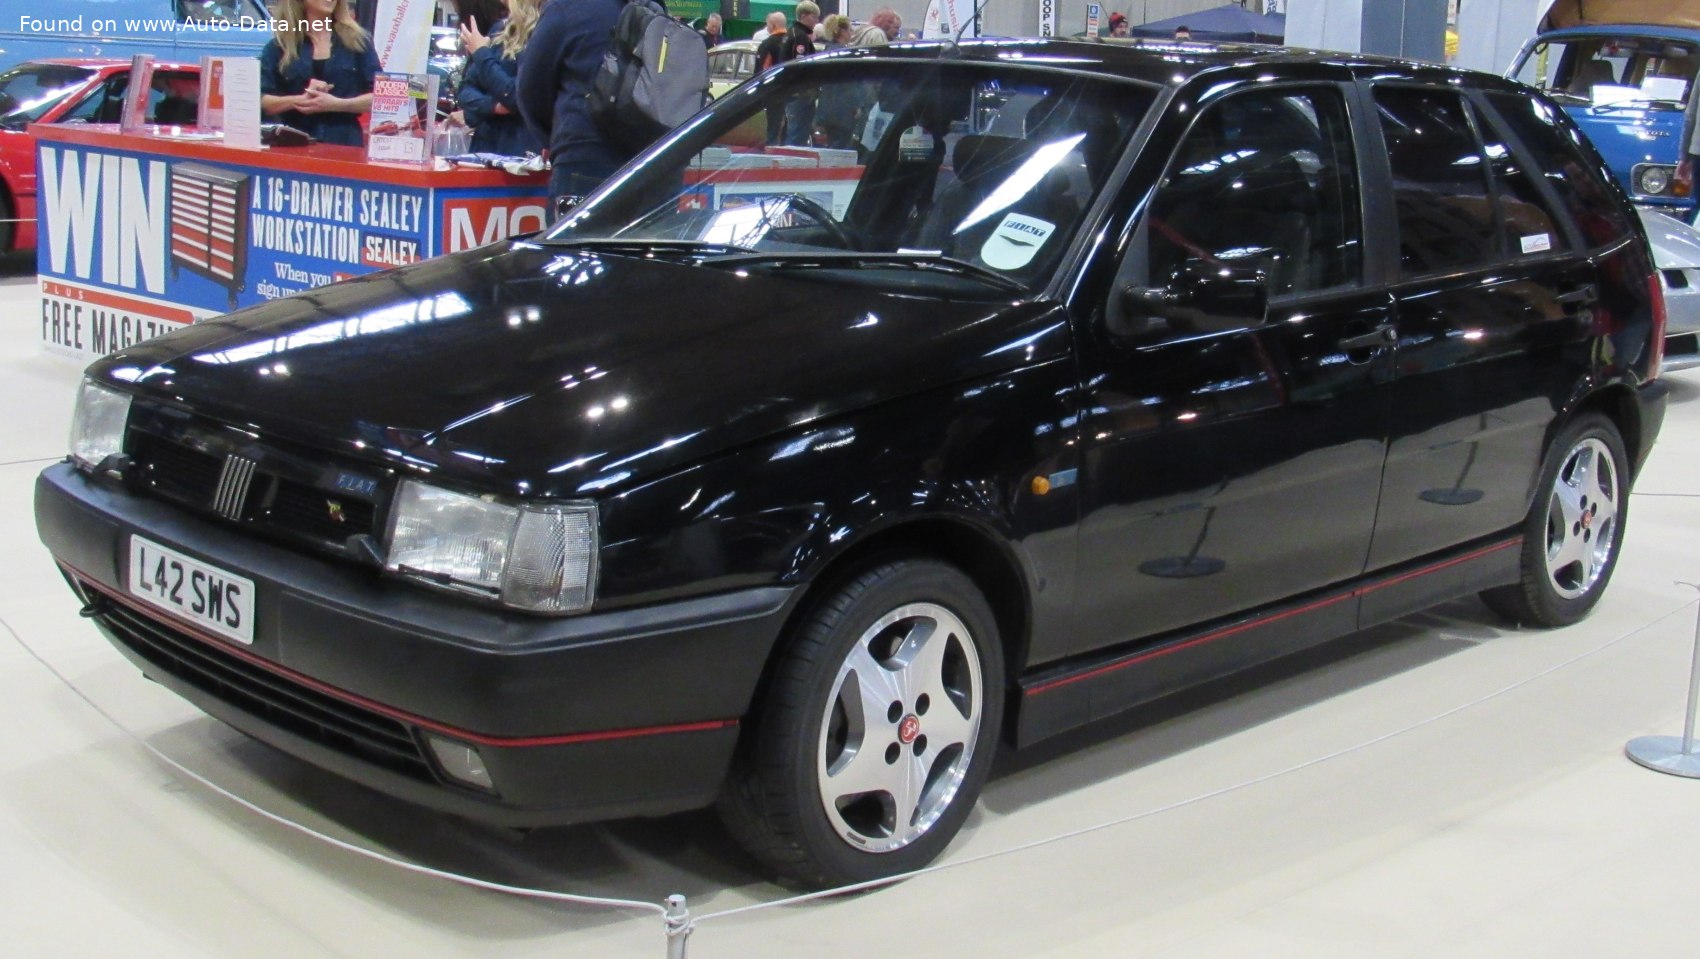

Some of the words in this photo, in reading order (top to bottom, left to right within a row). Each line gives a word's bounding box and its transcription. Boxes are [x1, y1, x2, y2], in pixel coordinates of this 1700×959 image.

[380, 0, 410, 68] www.vauxhallc
[374, 88, 409, 97] CLASSICS
[375, 80, 409, 91] MODERN
[252, 175, 262, 210] A
[267, 176, 353, 223] 16-DRAWER
[359, 189, 423, 233] SEALEY
[40, 146, 167, 294] WIN
[1004, 220, 1046, 237] FIAT
[252, 213, 360, 264] WORKSTATION
[366, 235, 417, 266] SEALEY
[274, 262, 309, 284] When
[310, 272, 332, 288] you
[43, 282, 84, 300] PLUS
[257, 279, 280, 300] sign
[42, 298, 83, 349] FREE
[337, 473, 378, 494] FIAT
[139, 546, 184, 606] L42
[191, 569, 241, 629] SWS
